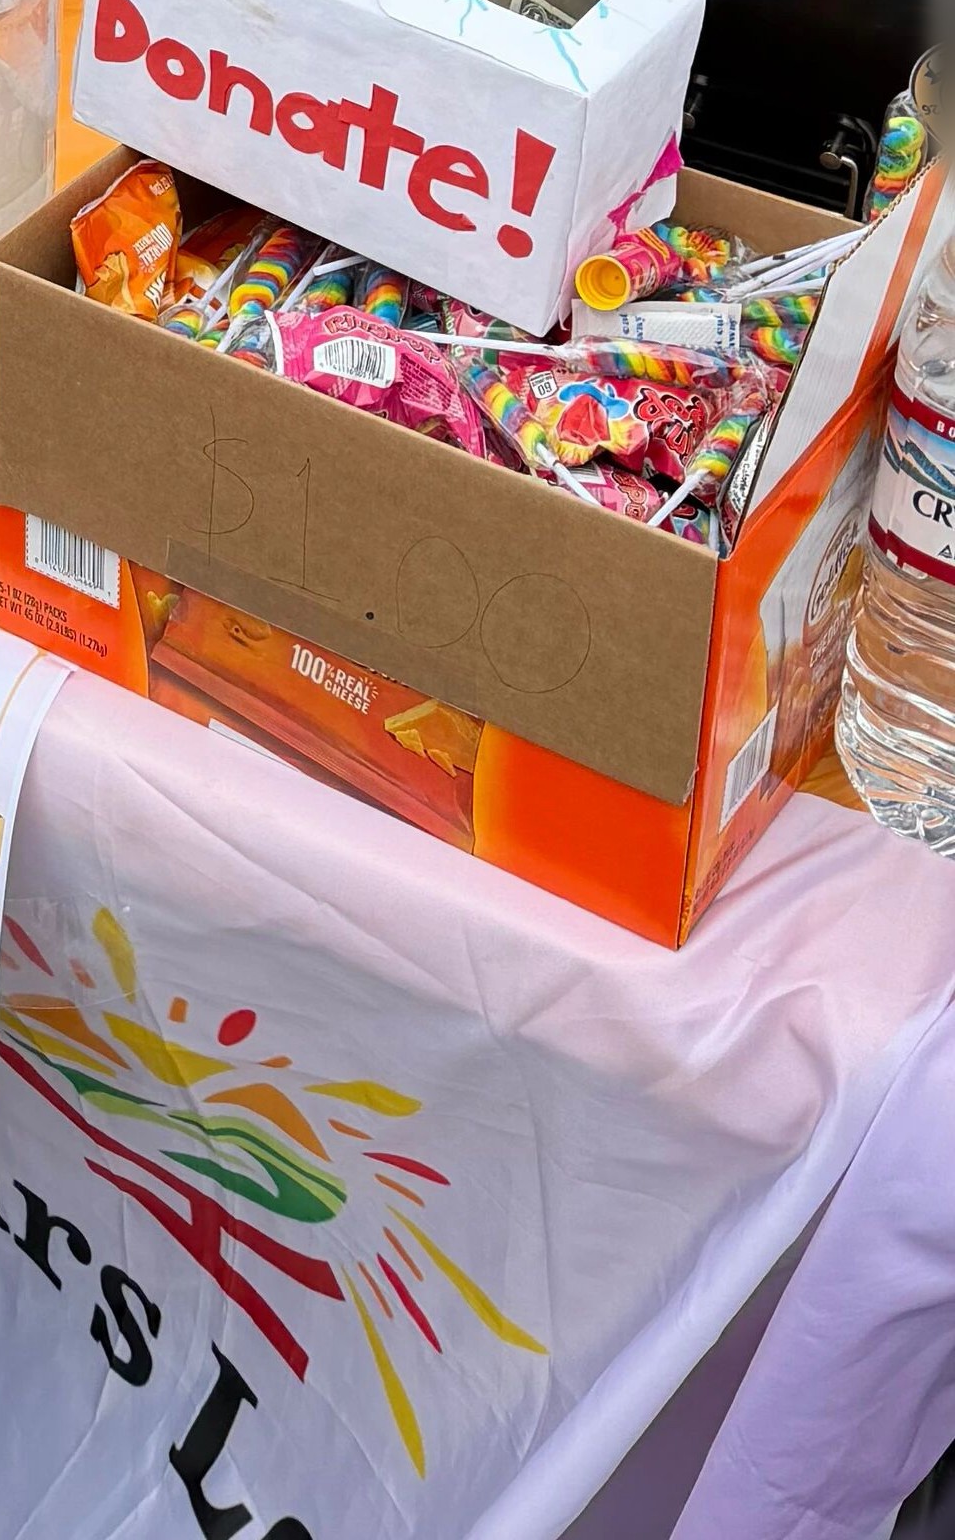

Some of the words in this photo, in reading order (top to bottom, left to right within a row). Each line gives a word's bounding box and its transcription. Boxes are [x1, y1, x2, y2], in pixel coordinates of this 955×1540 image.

[184, 404, 592, 694] $1.00
[9, 598, 22, 615] WT
[24, 605, 34, 621] 45
[34, 609, 45, 627] OZ
[44, 602, 68, 623] PACKS
[324, 679, 371, 716] CHEESE
[334, 667, 372, 704] REAL
